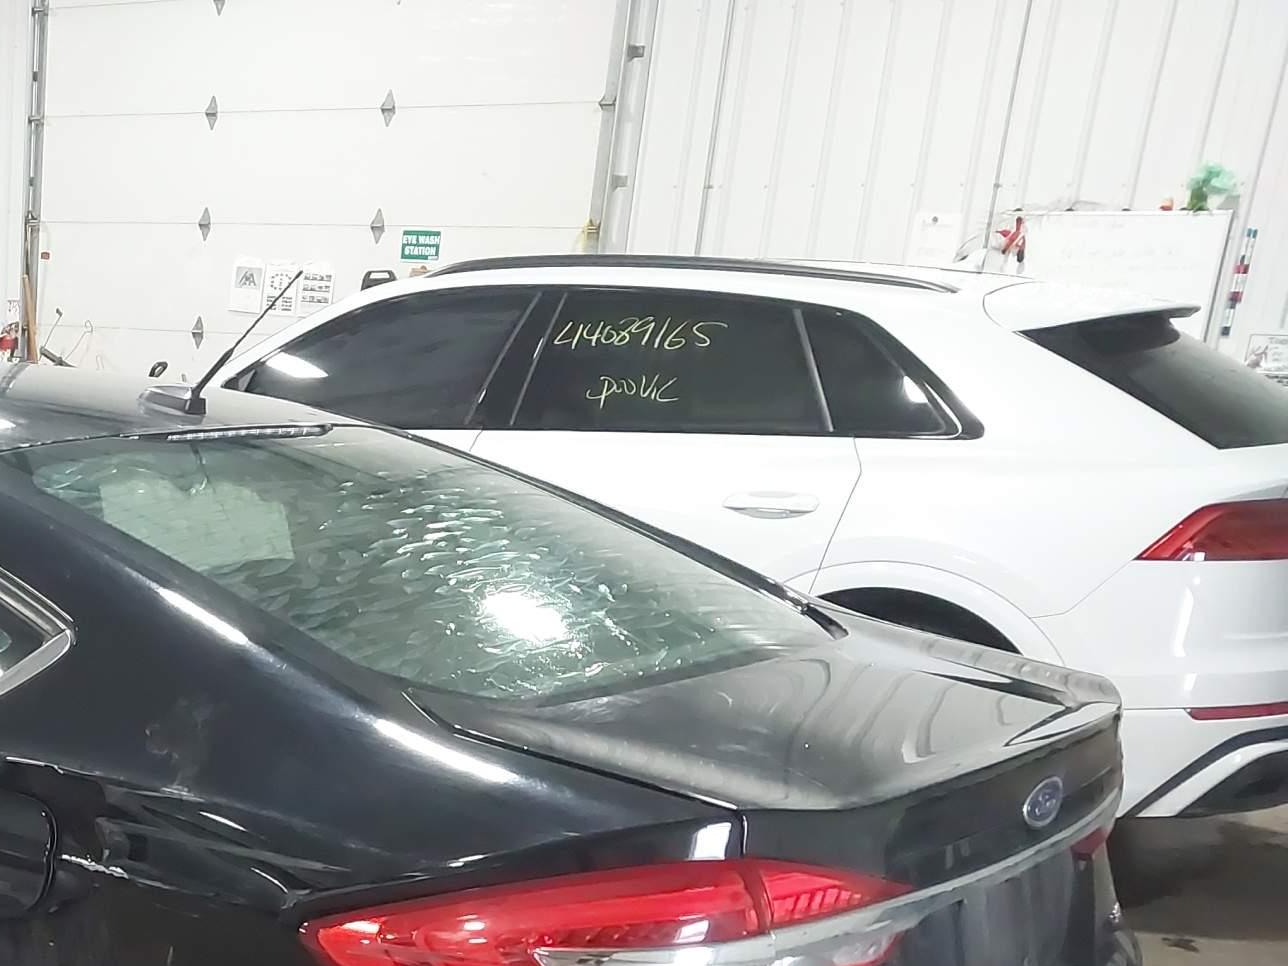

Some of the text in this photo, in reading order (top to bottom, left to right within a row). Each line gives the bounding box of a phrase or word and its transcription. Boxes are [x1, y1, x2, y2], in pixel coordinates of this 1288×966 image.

[402, 235, 441, 245] EYE WASH
[404, 245, 437, 256] STATION
